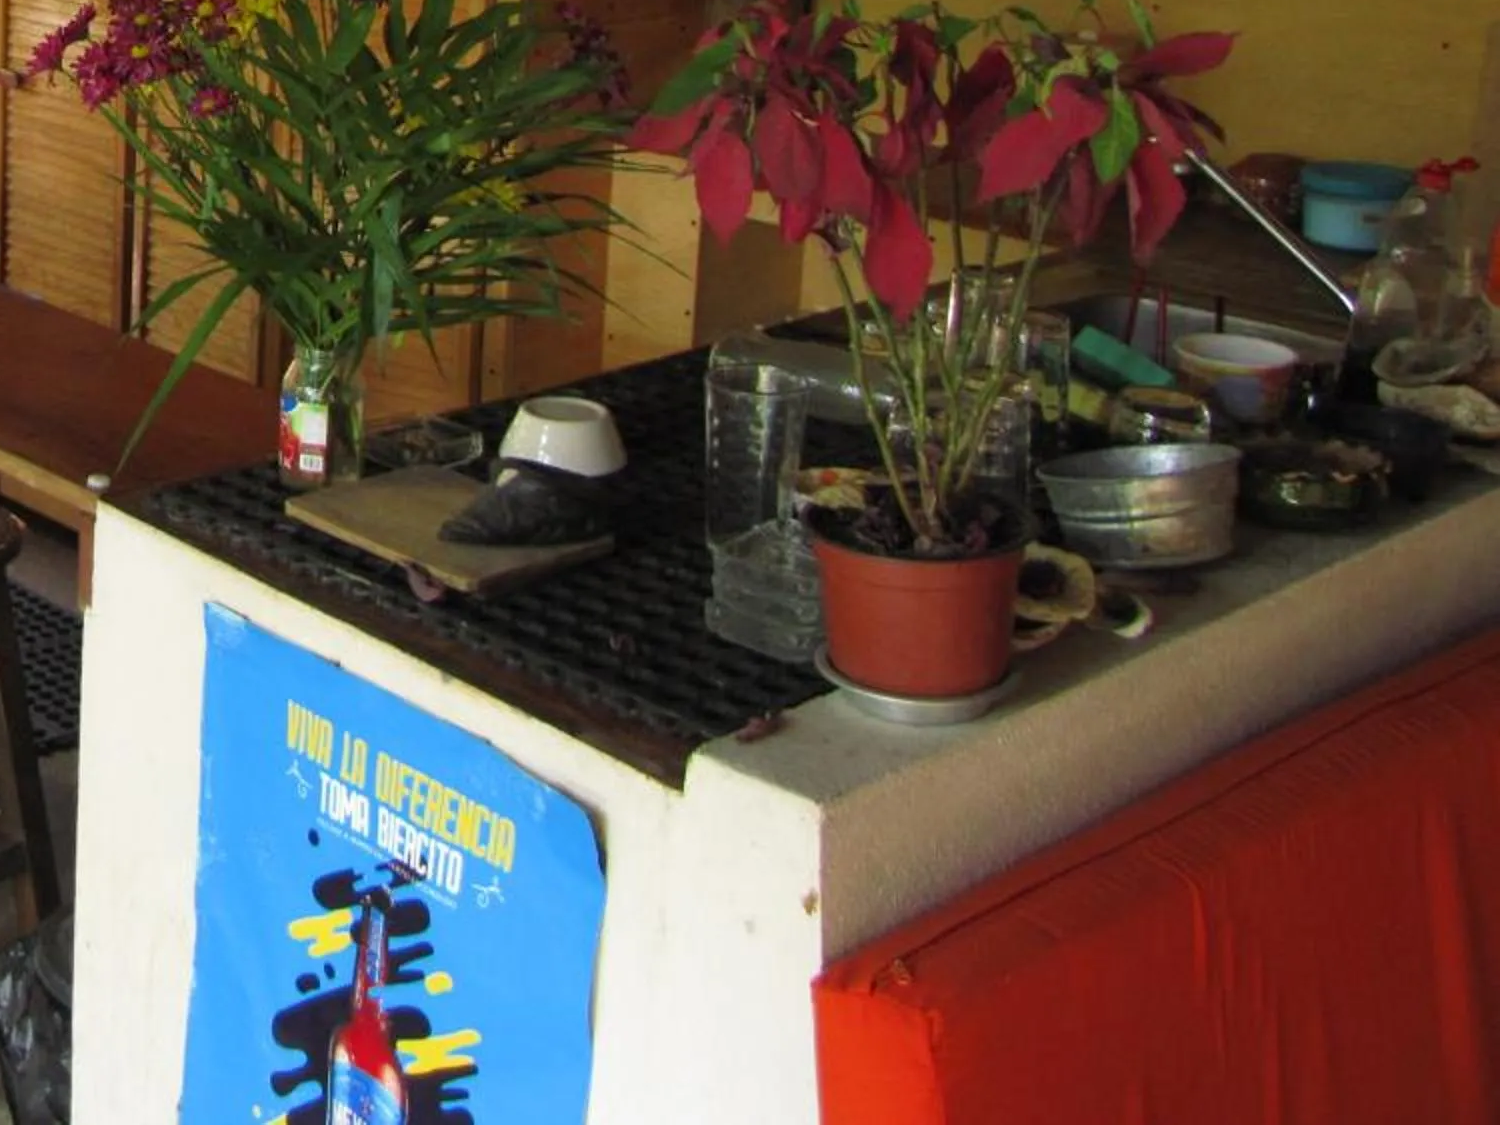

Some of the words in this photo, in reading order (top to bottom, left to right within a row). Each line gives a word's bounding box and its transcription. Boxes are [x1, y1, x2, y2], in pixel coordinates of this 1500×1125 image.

[287, 699, 333, 770] VIVA
[339, 730, 368, 789] LA
[375, 751, 516, 873] DIFERENCIA
[319, 770, 370, 837] TOMA
[377, 805, 464, 895] BIERCITO
